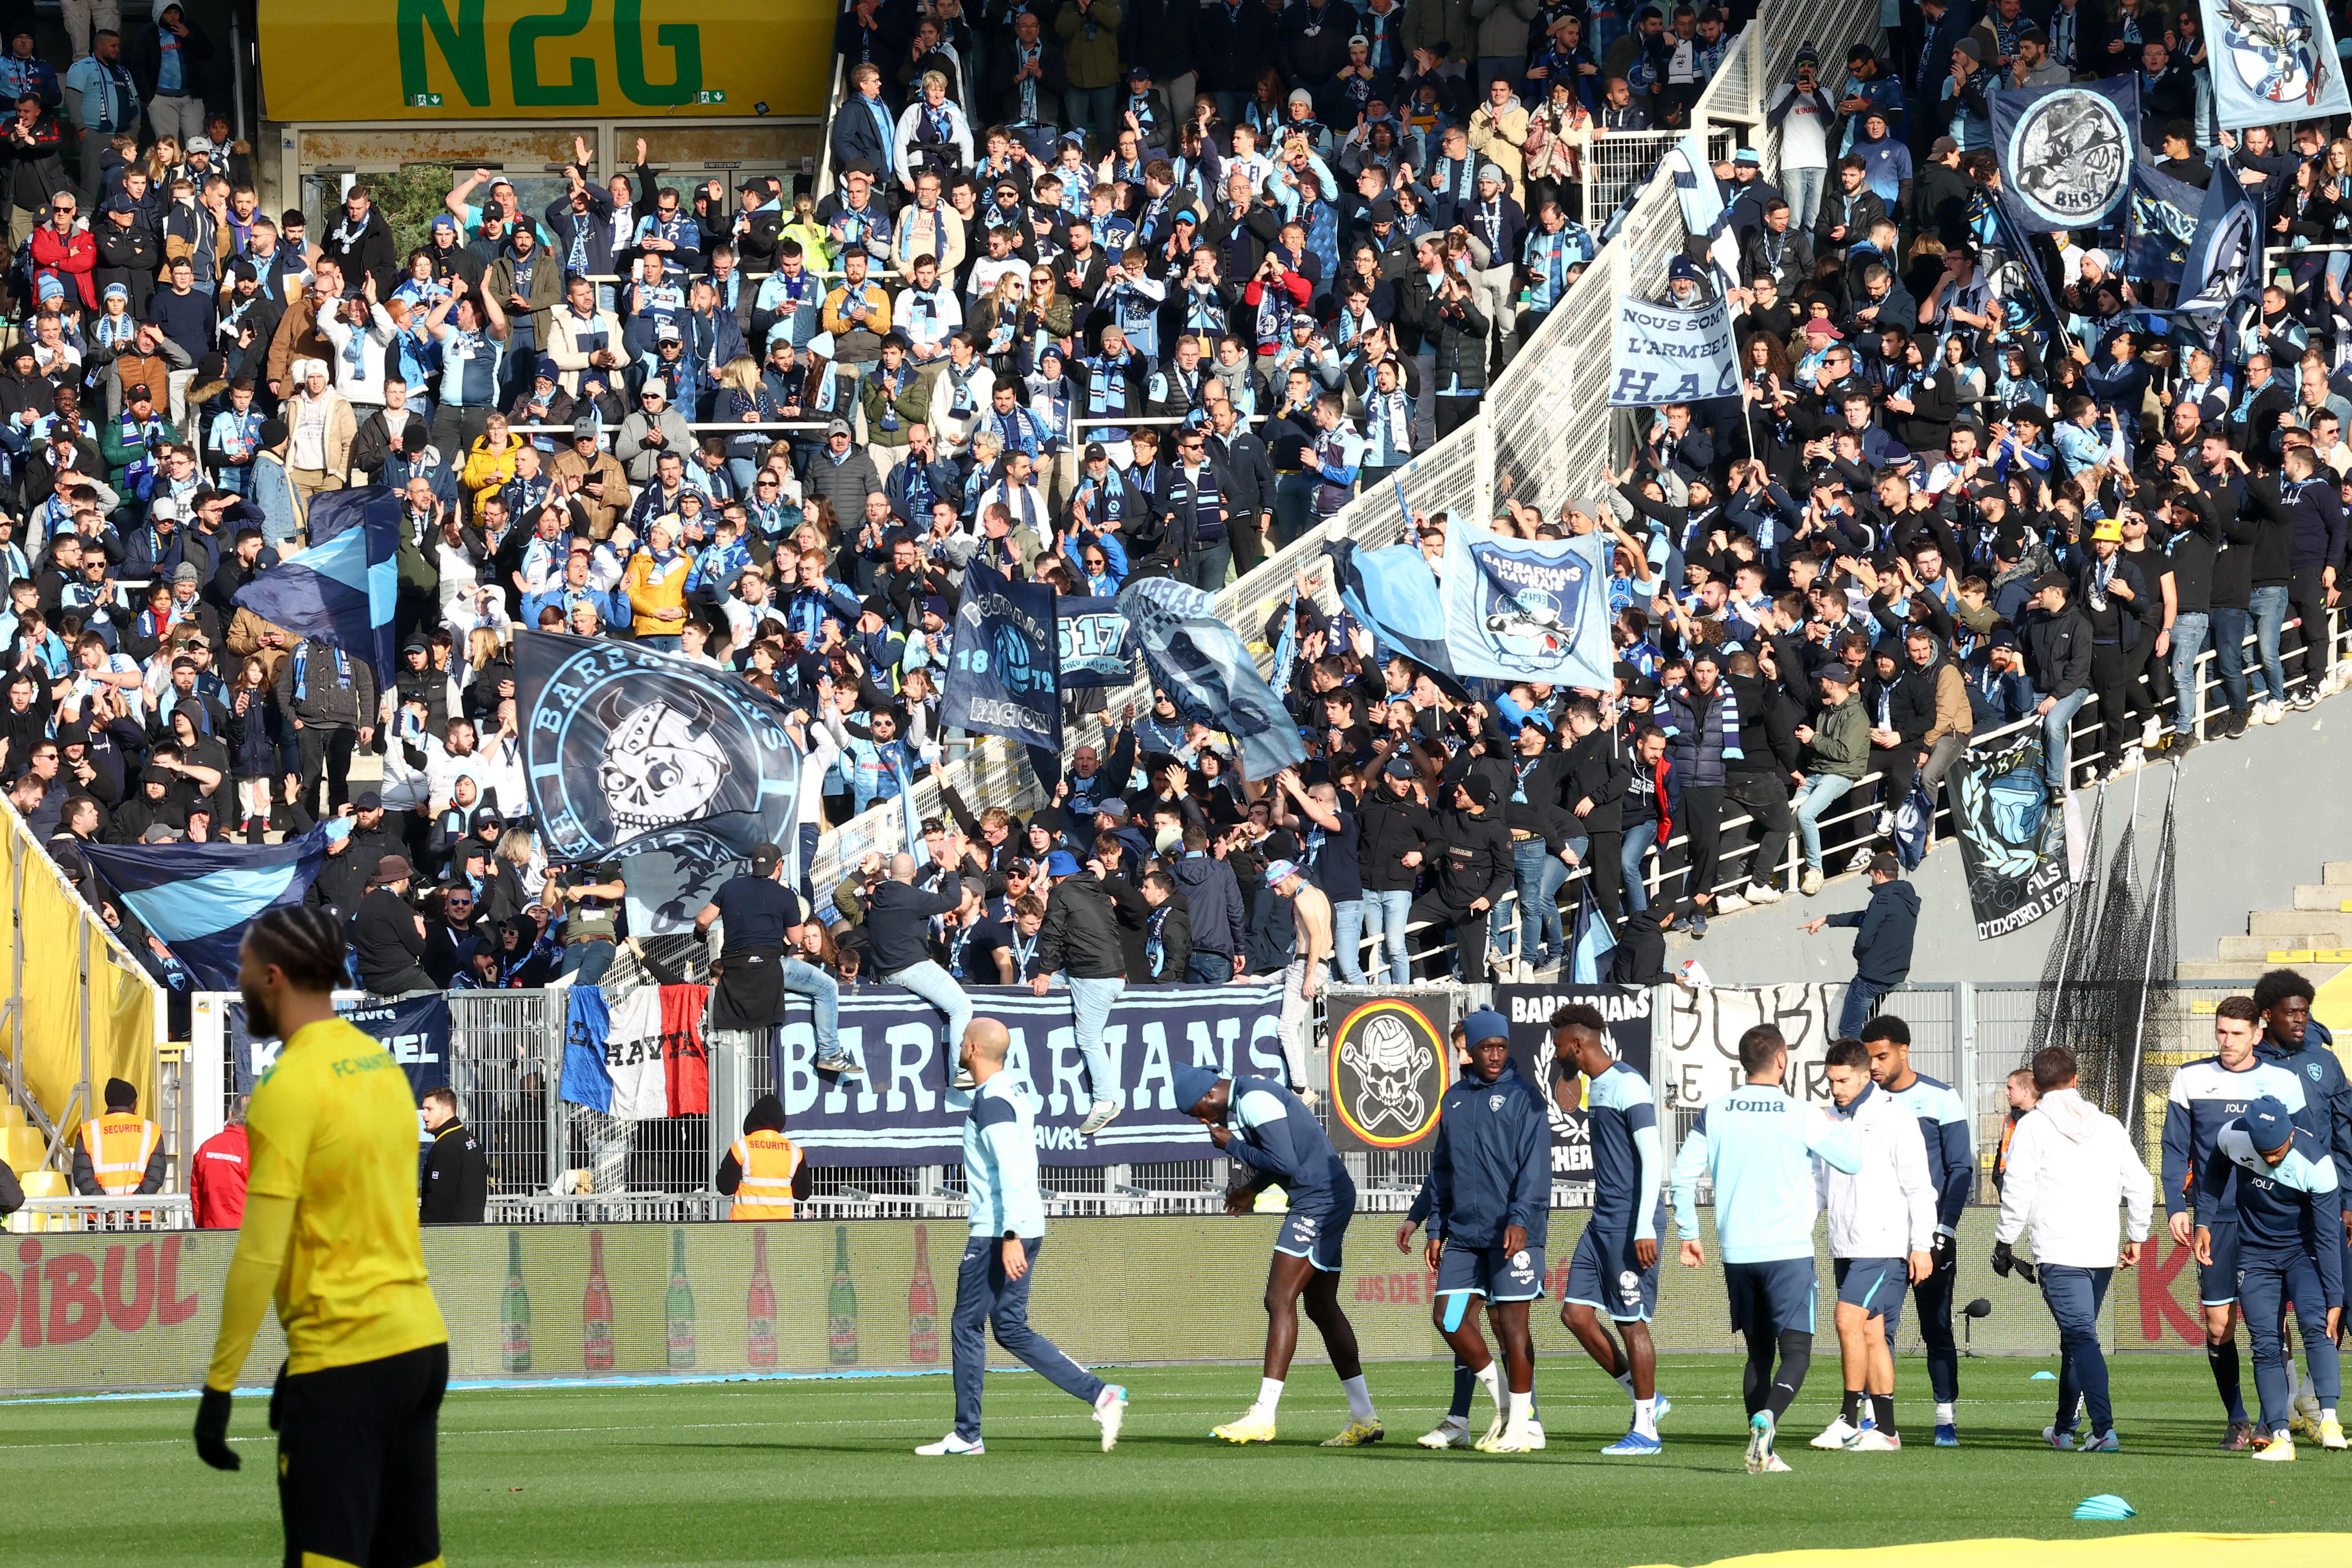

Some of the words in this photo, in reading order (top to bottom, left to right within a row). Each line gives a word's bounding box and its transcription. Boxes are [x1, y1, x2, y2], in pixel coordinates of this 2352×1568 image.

[396, 0, 704, 107] N2G
[2054, 190, 2103, 208] BH93
[1623, 309, 1681, 332] NOUS
[1628, 337, 1721, 359] L'ARMEE
[1481, 551, 1582, 581] BARBARIANS
[1497, 566, 1565, 592] HAVRAIS
[956, 648, 989, 674] 18
[1032, 670, 1056, 694] 72
[2027, 862, 2063, 895] FILS
[1977, 902, 2042, 939] D'OXFORD
[2039, 894, 2054, 913] &
[331, 1059, 356, 1079] FC
[780, 1015, 1288, 1117] BARARIANS
[104, 1124, 142, 1135] SECURITE
[749, 1140, 790, 1151] SECURITE
[1292, 1223, 1316, 1237] GEODIS
[1510, 1269, 1534, 1277] GEODIS
